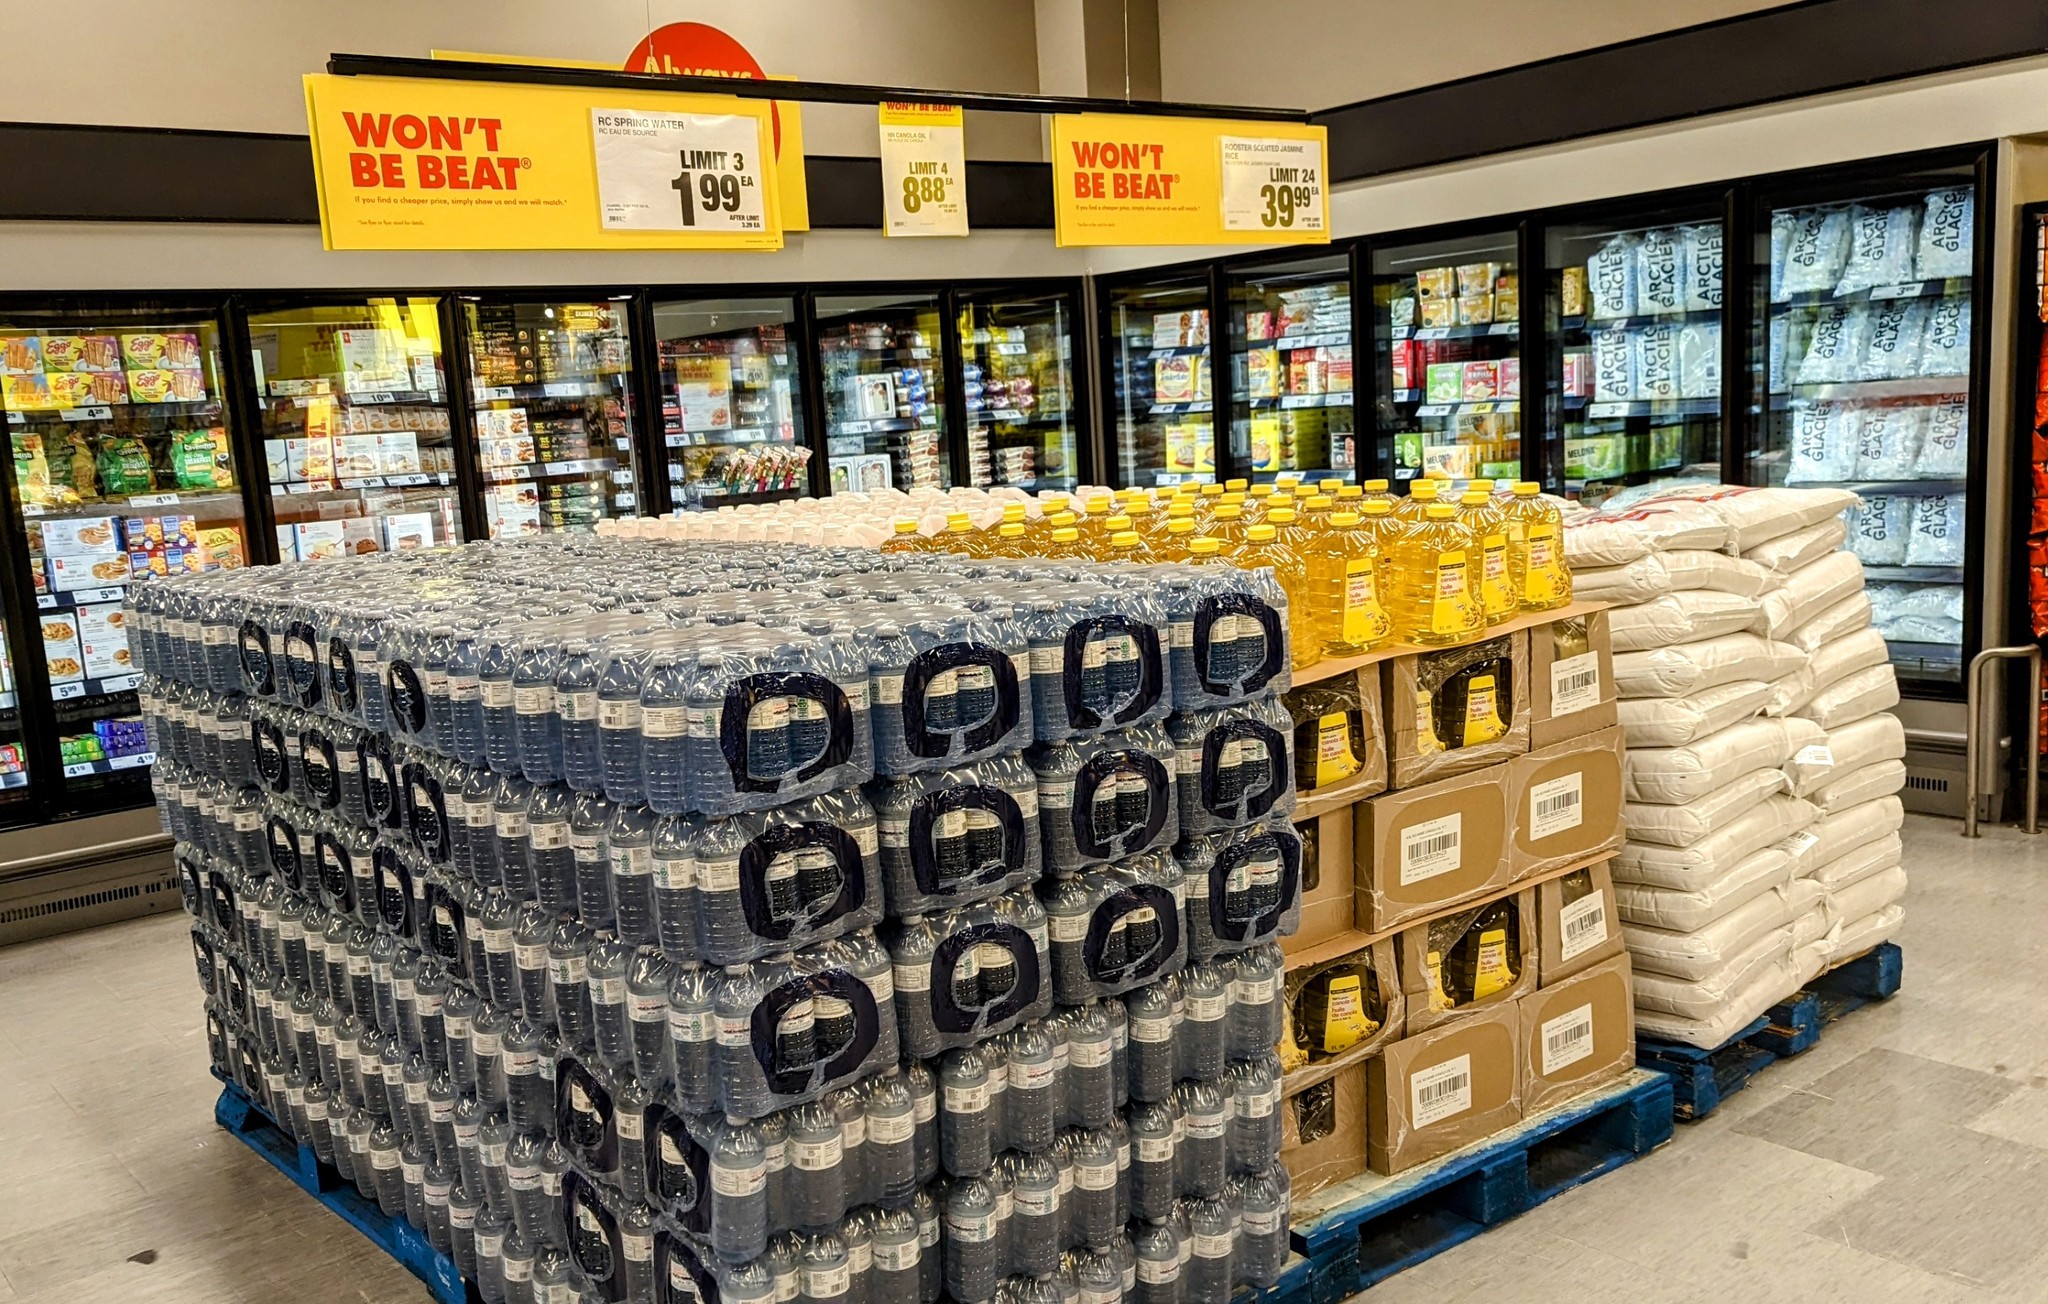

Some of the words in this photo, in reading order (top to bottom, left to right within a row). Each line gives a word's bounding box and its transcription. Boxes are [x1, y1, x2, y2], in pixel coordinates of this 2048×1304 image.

[598, 116, 612, 127] RC
[614, 117, 649, 128] SPRING
[651, 119, 685, 130] WATER
[341, 111, 502, 152] WON'T
[1071, 141, 1164, 170] WON'T
[1225, 144, 1252, 152] ROOSTER
[1253, 144, 1279, 152] SCENTED
[1280, 145, 1304, 153] JASMINE
[680, 150, 727, 170] LIMIT
[733, 152, 744, 171] 3
[349, 152, 406, 188] BE
[909, 162, 938, 175] LIMIT
[941, 162, 948, 175] 4
[1270, 167, 1298, 183] LIMIT
[1302, 168, 1315, 183] 24
[741, 176, 754, 187] EA
[945, 178, 954, 186] EA
[1074, 172, 1106, 199] BE
[1311, 186, 1319, 195] EA
[361, 197, 375, 206] you
[377, 196, 391, 204] find
[400, 196, 429, 205] cheaper
[430, 197, 449, 206] price,
[451, 198, 473, 206] simply
[503, 198, 517, 206] and
[530, 198, 541, 206] will
[1645, 239, 1661, 302] ARCTIC
[1697, 236, 1711, 301] ARCTIC
[46, 340, 71, 355] Eggo
[130, 337, 155, 352] Eggo
[136, 372, 161, 387] Eggo
[1943, 394, 1966, 450] GLACIE
[184, 442, 217, 451] Cavendish
